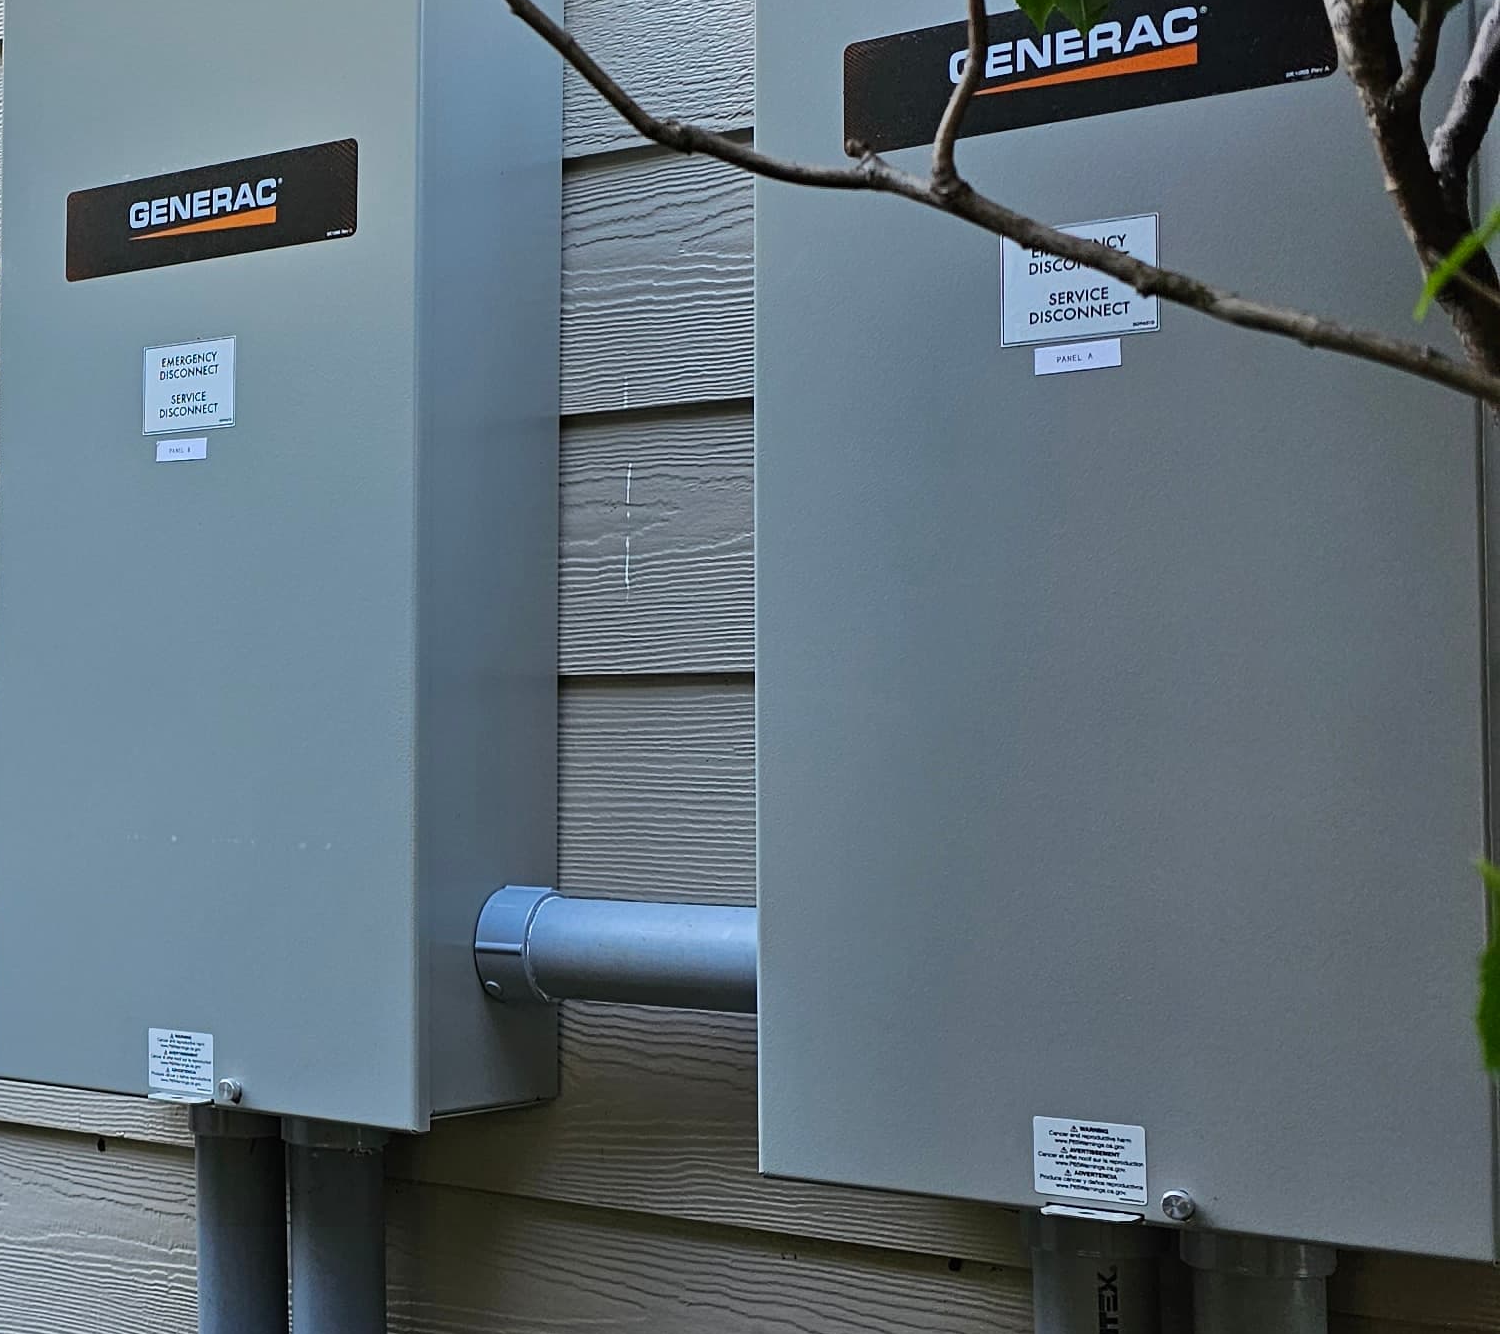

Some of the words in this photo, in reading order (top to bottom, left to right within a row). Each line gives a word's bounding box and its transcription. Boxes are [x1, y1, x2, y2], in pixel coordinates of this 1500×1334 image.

[129, 177, 277, 229] GENERAC
[1049, 286, 1109, 306] SERVICE
[1029, 301, 1131, 325] DISCONNECT
[161, 351, 218, 368] EMERGENCY
[1056, 353, 1082, 363] PANEL
[159, 364, 219, 380] DISCONNECT
[171, 391, 207, 405] SERVICE
[159, 403, 219, 419] DISCONNECT
